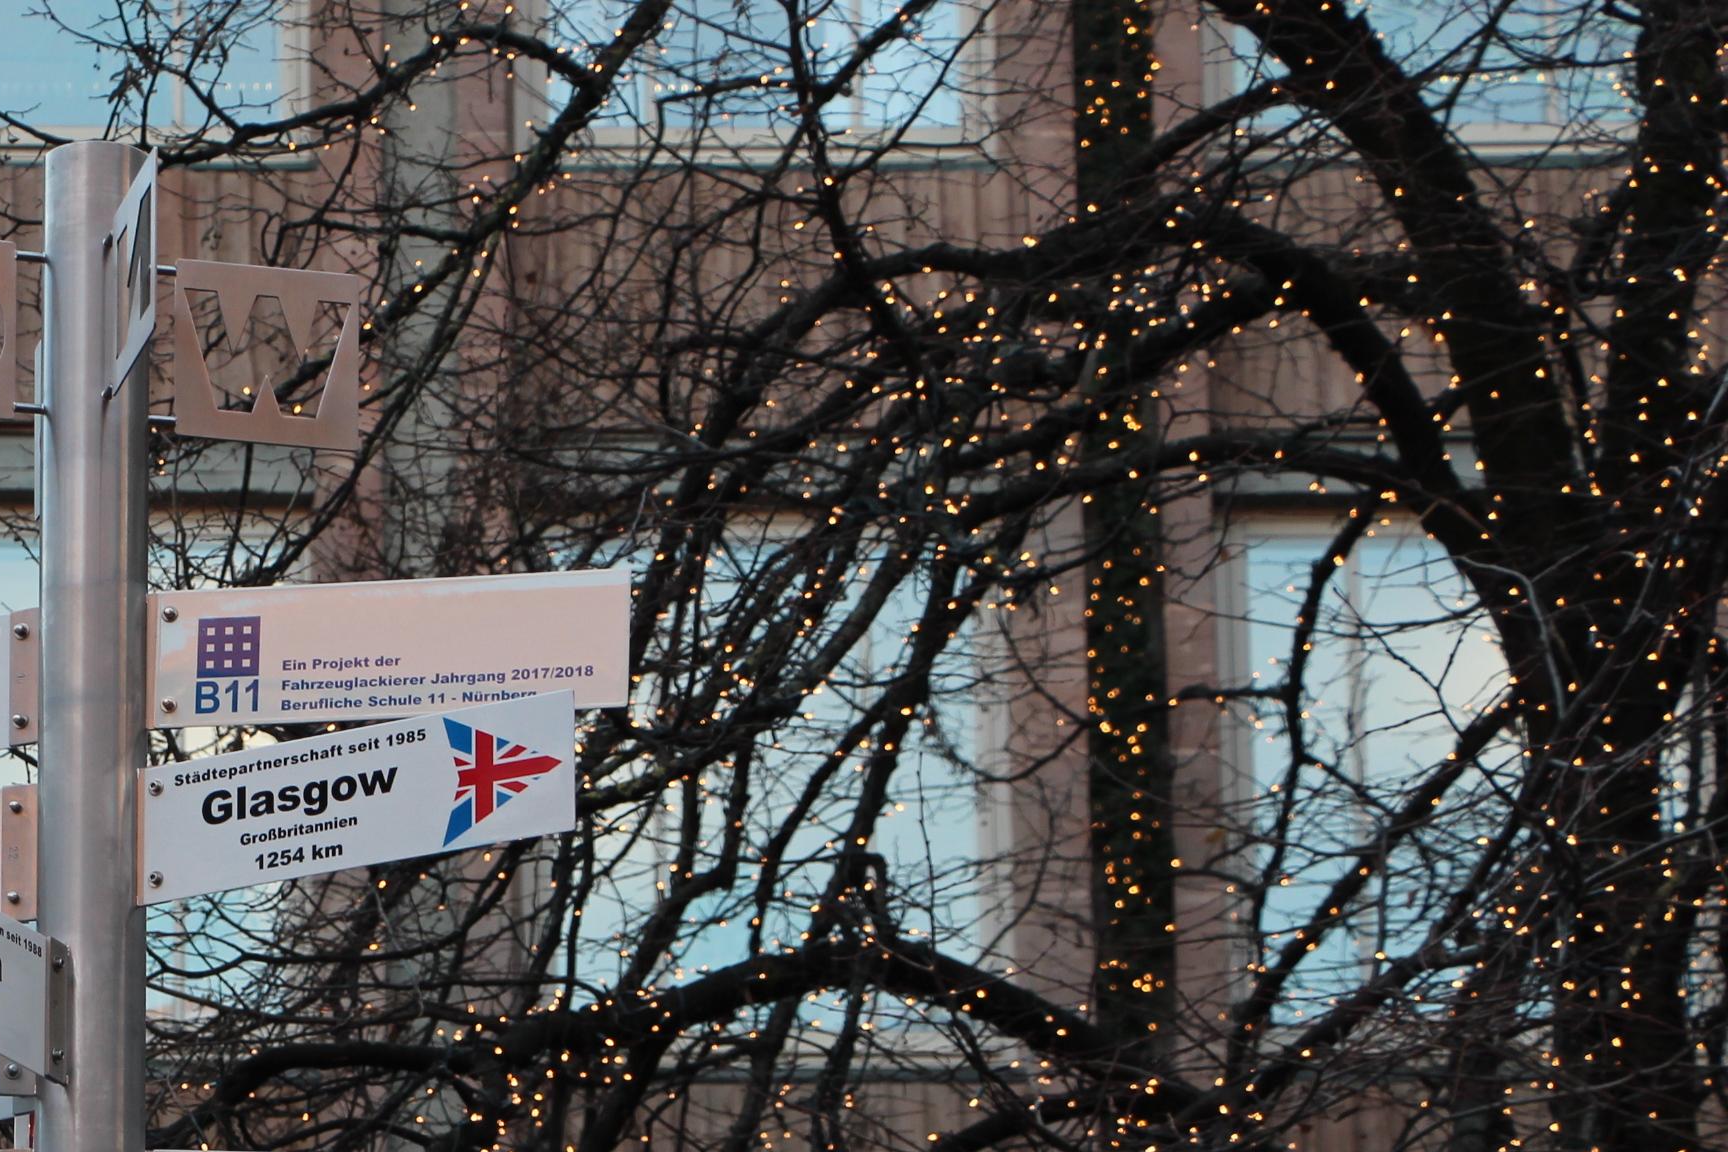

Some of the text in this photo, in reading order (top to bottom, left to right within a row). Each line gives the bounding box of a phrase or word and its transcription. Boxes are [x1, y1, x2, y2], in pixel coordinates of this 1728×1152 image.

[183, 287, 353, 419] W
[282, 656, 401, 672] Ein Projekt der
[282, 665, 594, 691] Fahrzeuglackierer Jahrgang 2017/2018
[195, 679, 259, 714] B11
[281, 697, 363, 711] Berufliche
[368, 694, 422, 707] Schule
[428, 692, 445, 704] 11
[174, 728, 426, 786] Städtepartnerschaft seit 1985
[202, 763, 398, 829] Glasgow
[240, 816, 358, 846] Großbritannien
[255, 844, 343, 870] 1254 km
[6, 931, 22, 946] seit
[24, 938, 42, 958] 1988
